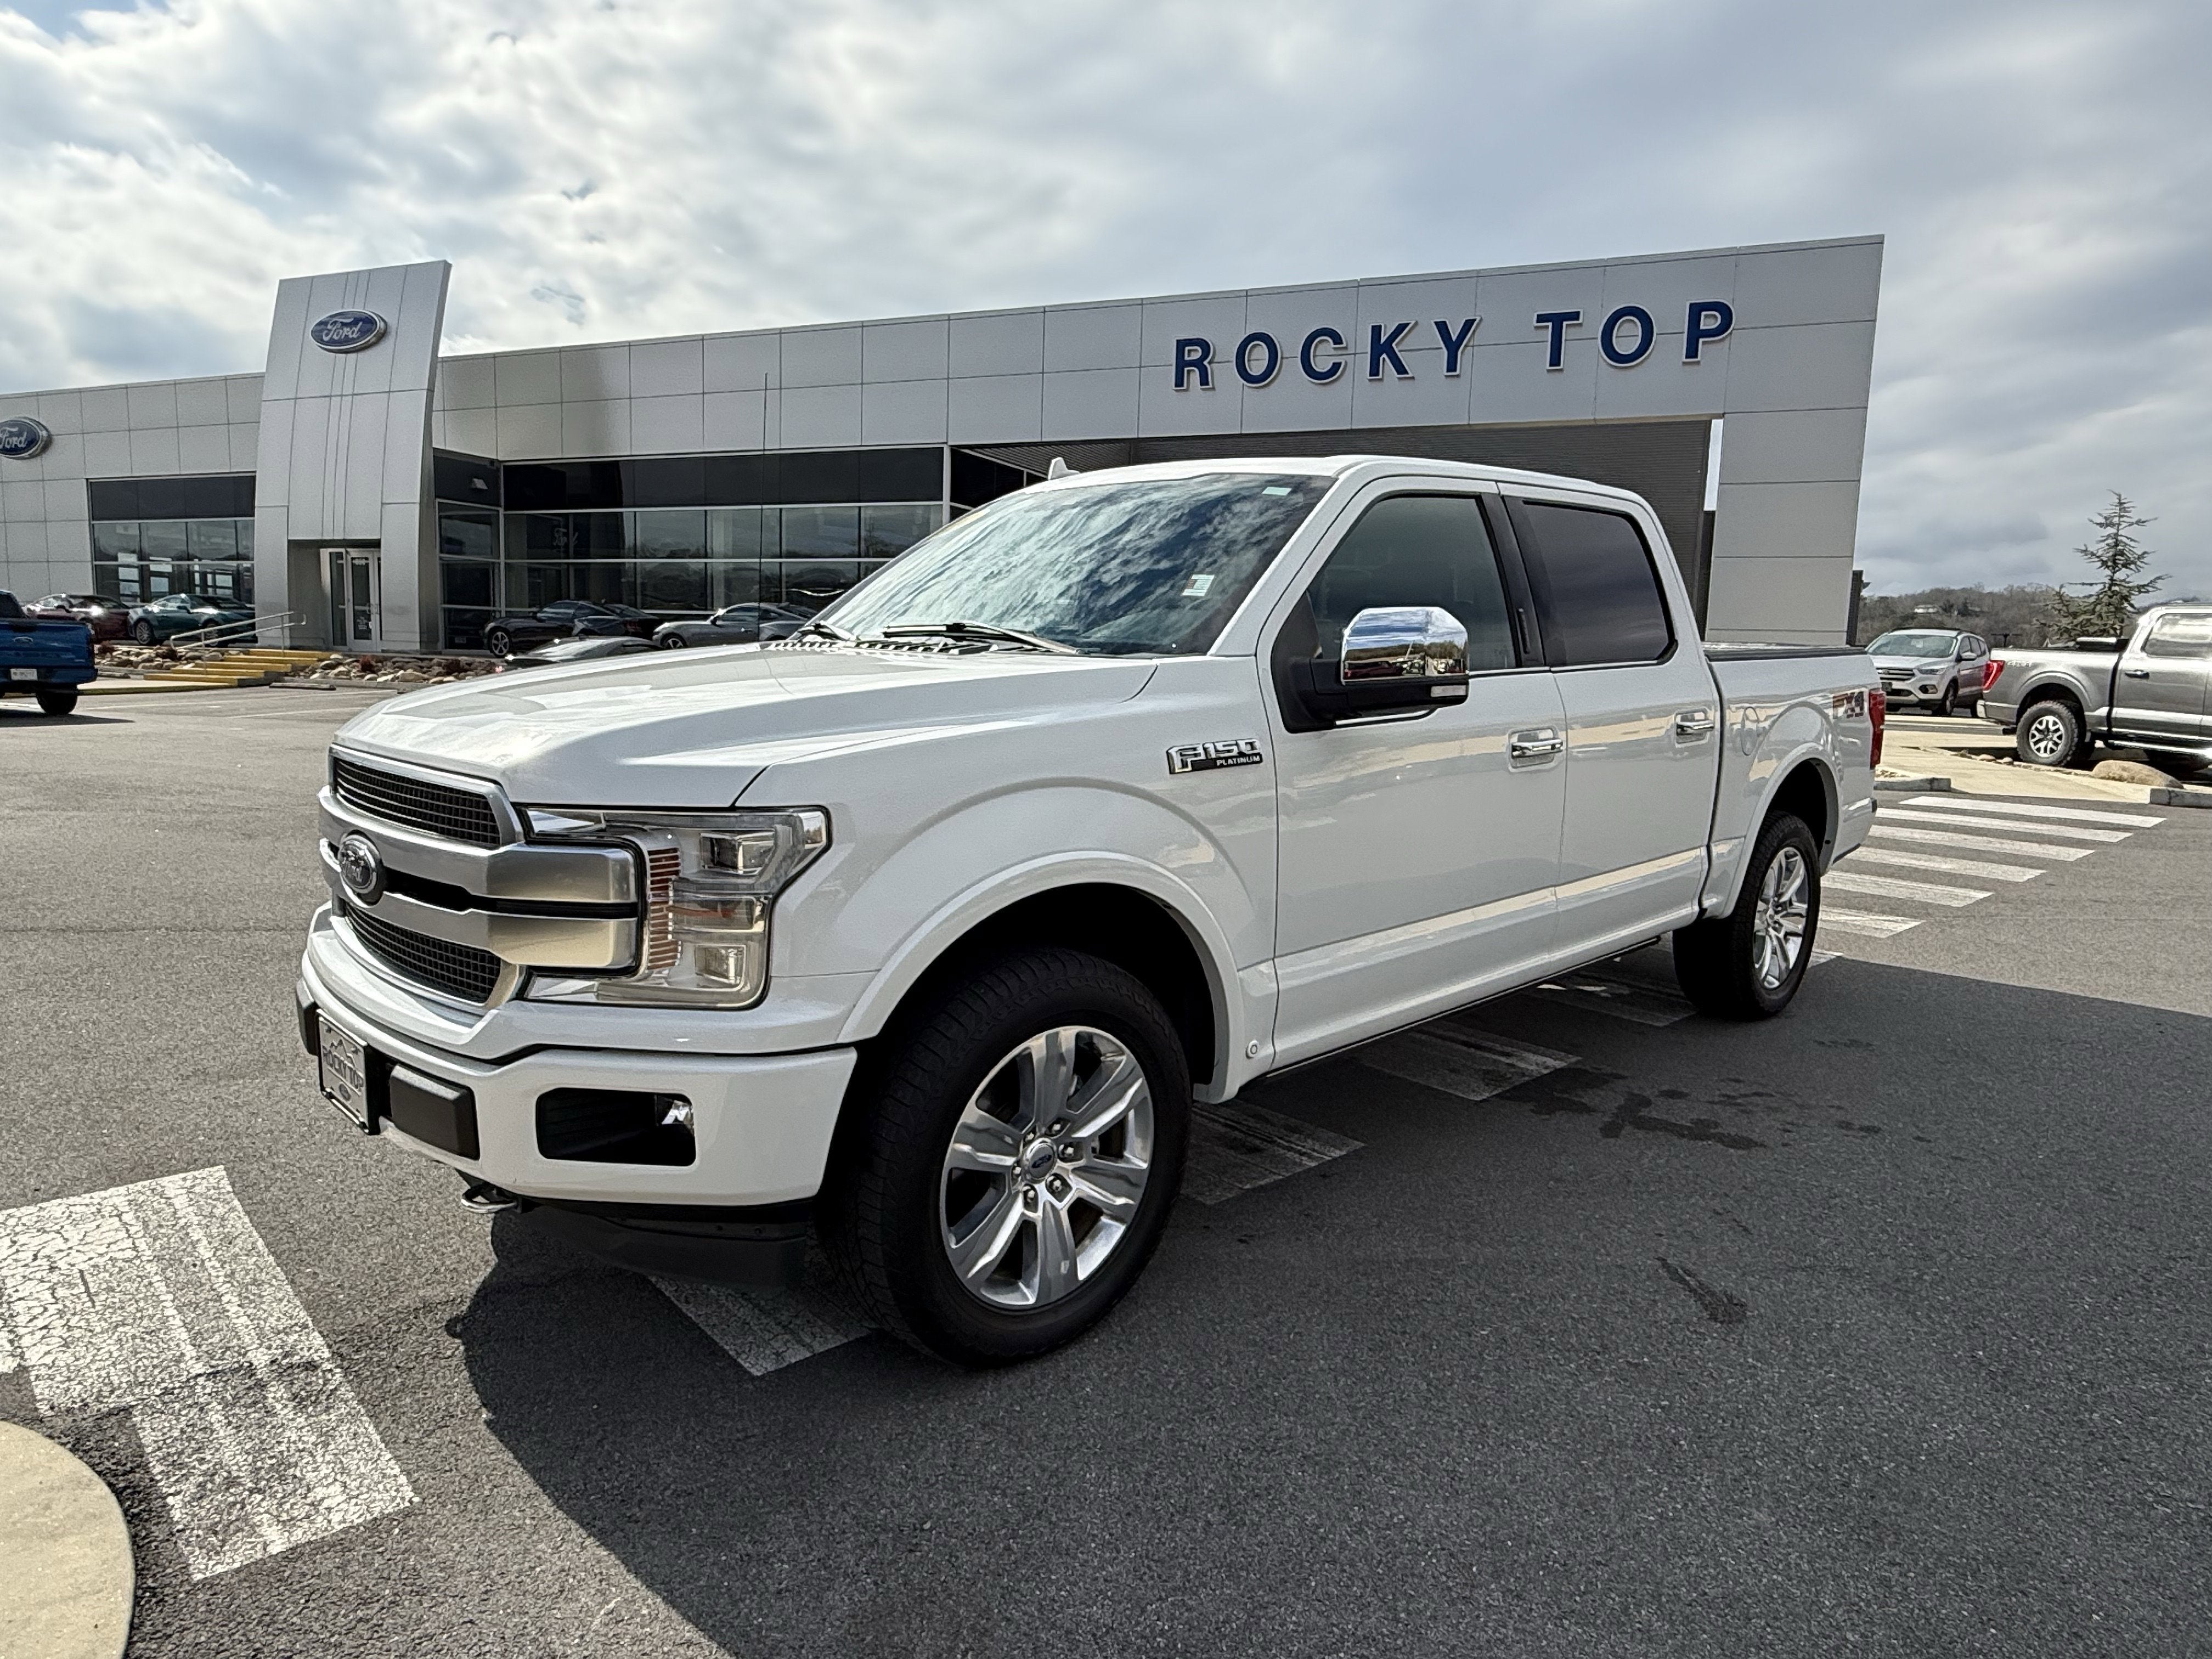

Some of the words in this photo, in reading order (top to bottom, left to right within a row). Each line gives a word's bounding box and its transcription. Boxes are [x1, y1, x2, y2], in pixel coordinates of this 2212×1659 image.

[323, 318, 363, 341] Ford
[1173, 315, 1481, 390] ROCKY
[1533, 299, 1735, 372] TOP
[1216, 754, 1261, 767] PLATINUM
[322, 1045, 348, 1080] ROCKY
[347, 1065, 364, 1091] TOP
